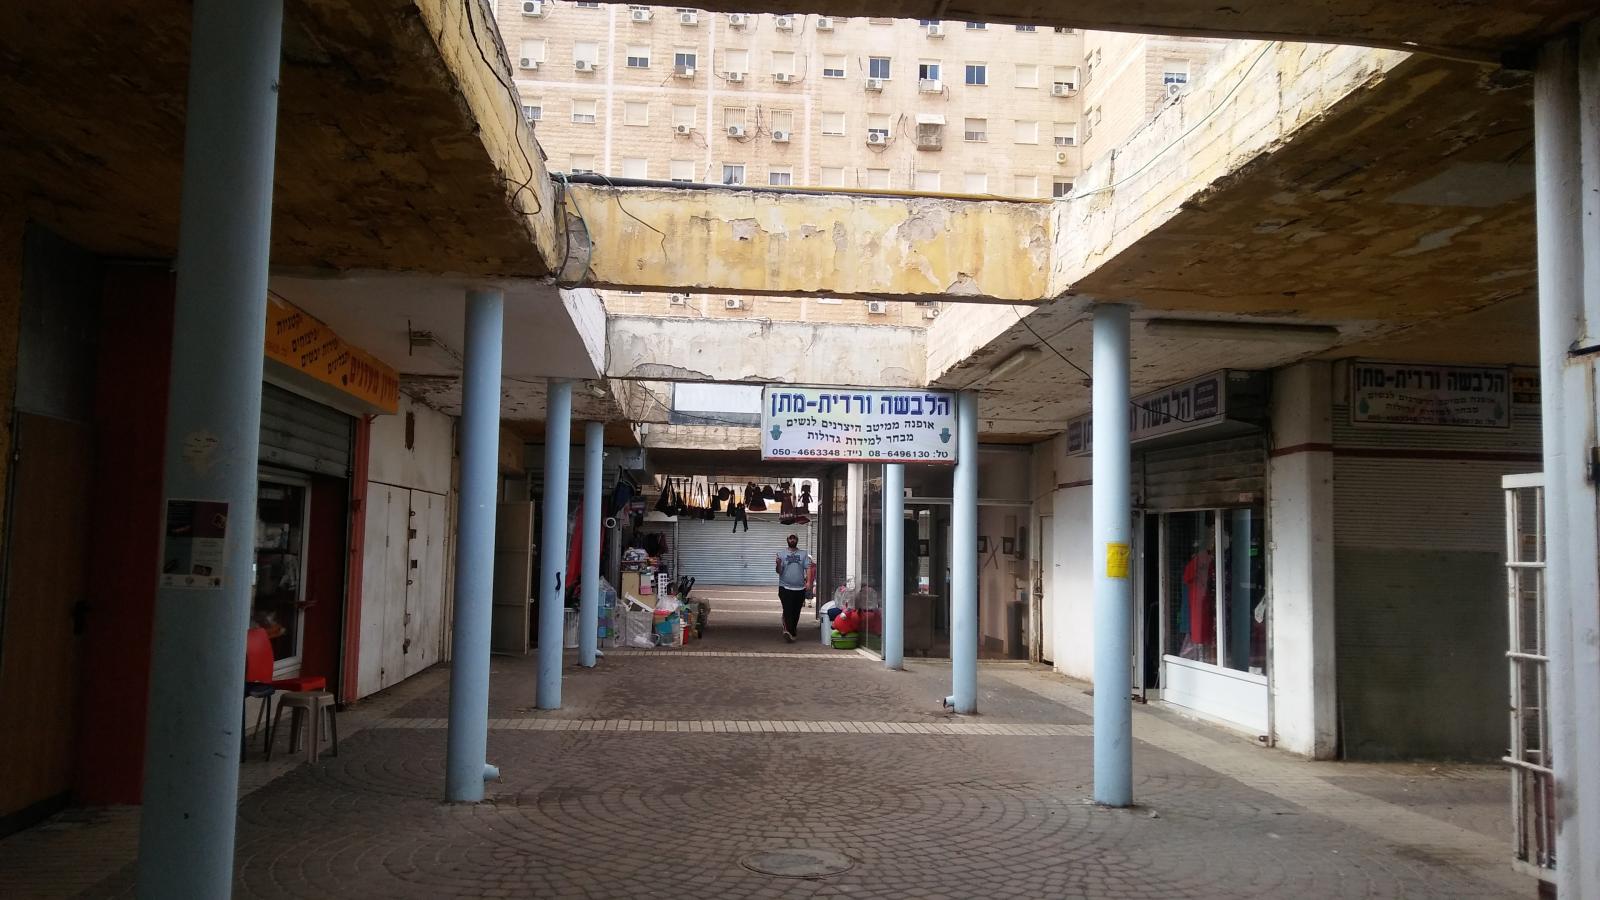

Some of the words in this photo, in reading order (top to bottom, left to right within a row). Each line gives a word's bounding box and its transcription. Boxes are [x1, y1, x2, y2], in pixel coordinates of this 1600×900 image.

[1357, 367, 1440, 391] ורדית-מתן
[1447, 372, 1504, 392] הלבשה
[771, 392, 873, 417] ורדית-מתן
[880, 394, 951, 416] הלבשה
[1143, 388, 1190, 428] הלבשה
[786, 416, 817, 427] לנשים
[821, 419, 862, 433] היצרנים
[866, 421, 900, 433] ממיטב
[904, 420, 935, 430] אופנה
[807, 430, 842, 444] גדולות
[845, 435, 882, 446] למידות
[886, 433, 914, 444] מבחר
[772, 448, 840, 457] 050-4663348
[868, 450, 930, 458] 08-6496130
[933, 450, 949, 458] טל:
